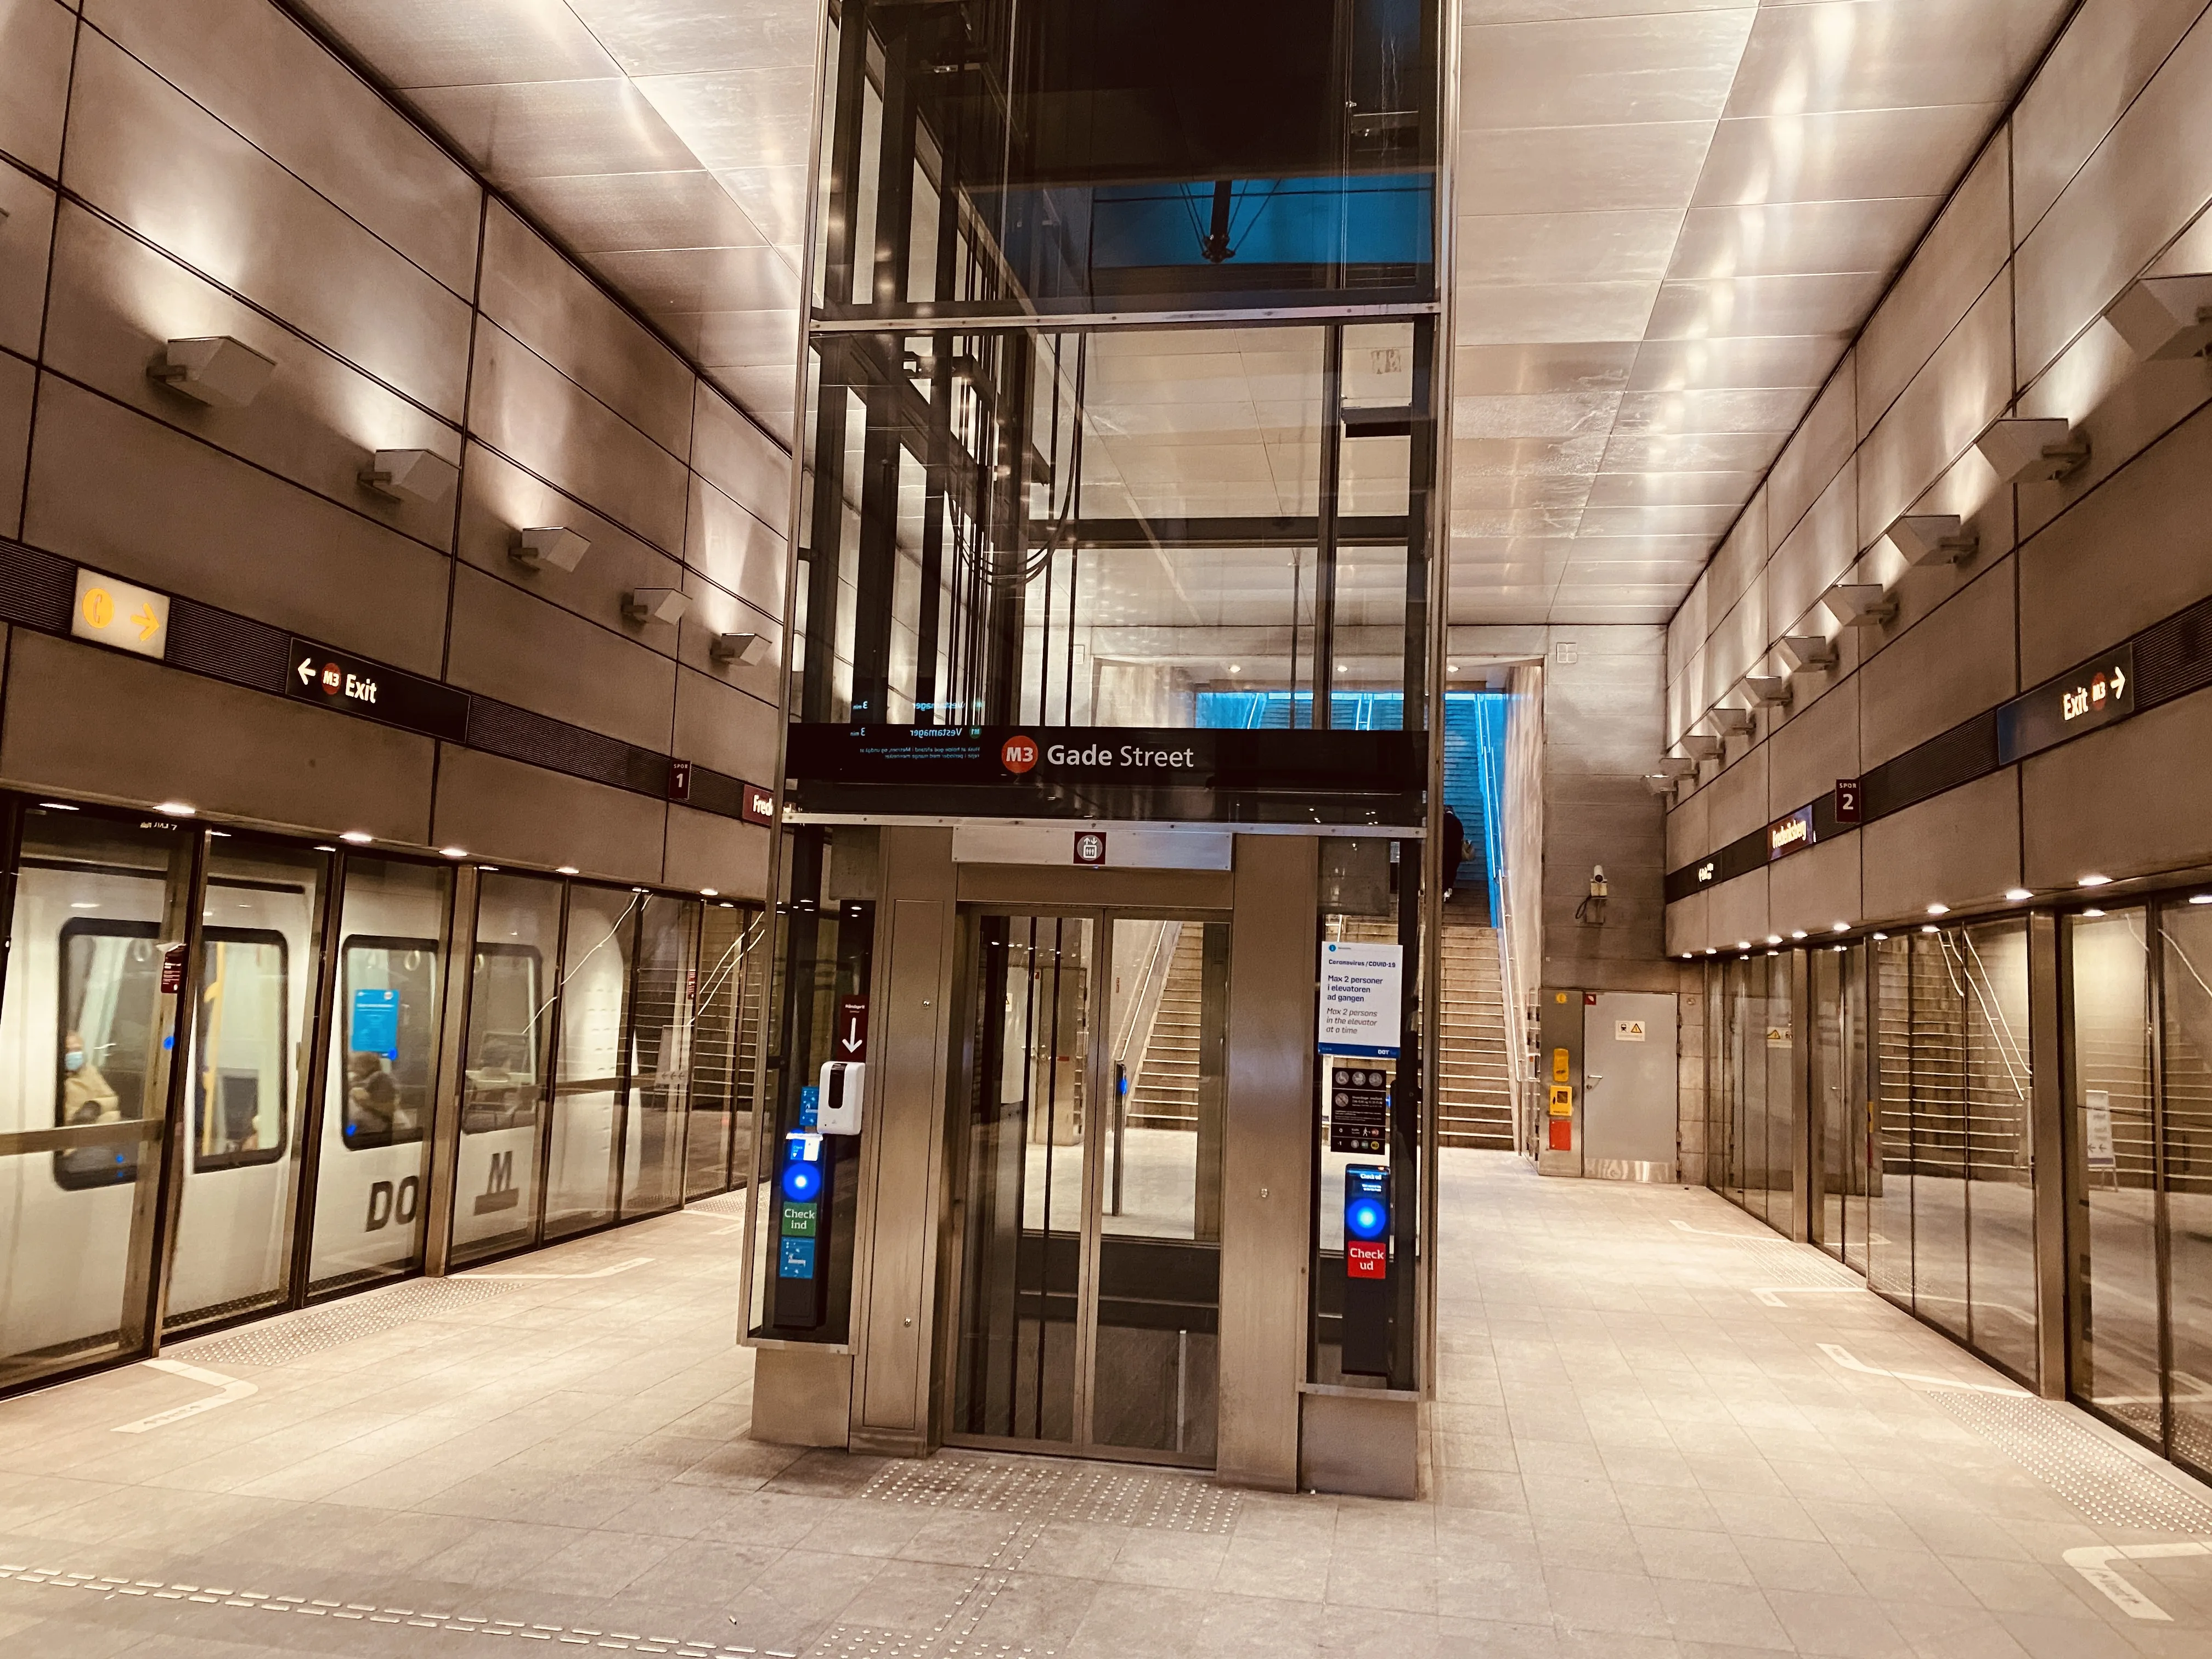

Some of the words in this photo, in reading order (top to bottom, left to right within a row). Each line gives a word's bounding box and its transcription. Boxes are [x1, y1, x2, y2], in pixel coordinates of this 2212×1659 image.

[323, 670, 339, 687] M3
[345, 674, 377, 703] Exit
[2063, 687, 2089, 721] Exit
[2092, 682, 2106, 702] M3
[1006, 747, 1034, 763] M3
[1047, 744, 1113, 766] Gade
[1120, 745, 1194, 768] Street
[676, 774, 683, 788] 1
[1842, 793, 1854, 810] 2
[1351, 977, 1384, 985] personer
[1331, 985, 1371, 993] elevatoren
[1326, 1007, 1341, 1015] Max
[784, 1209, 815, 1219] Check
[791, 1220, 807, 1229] ind
[1350, 1248, 1384, 1260] Check
[1359, 1261, 1374, 1270] ud
